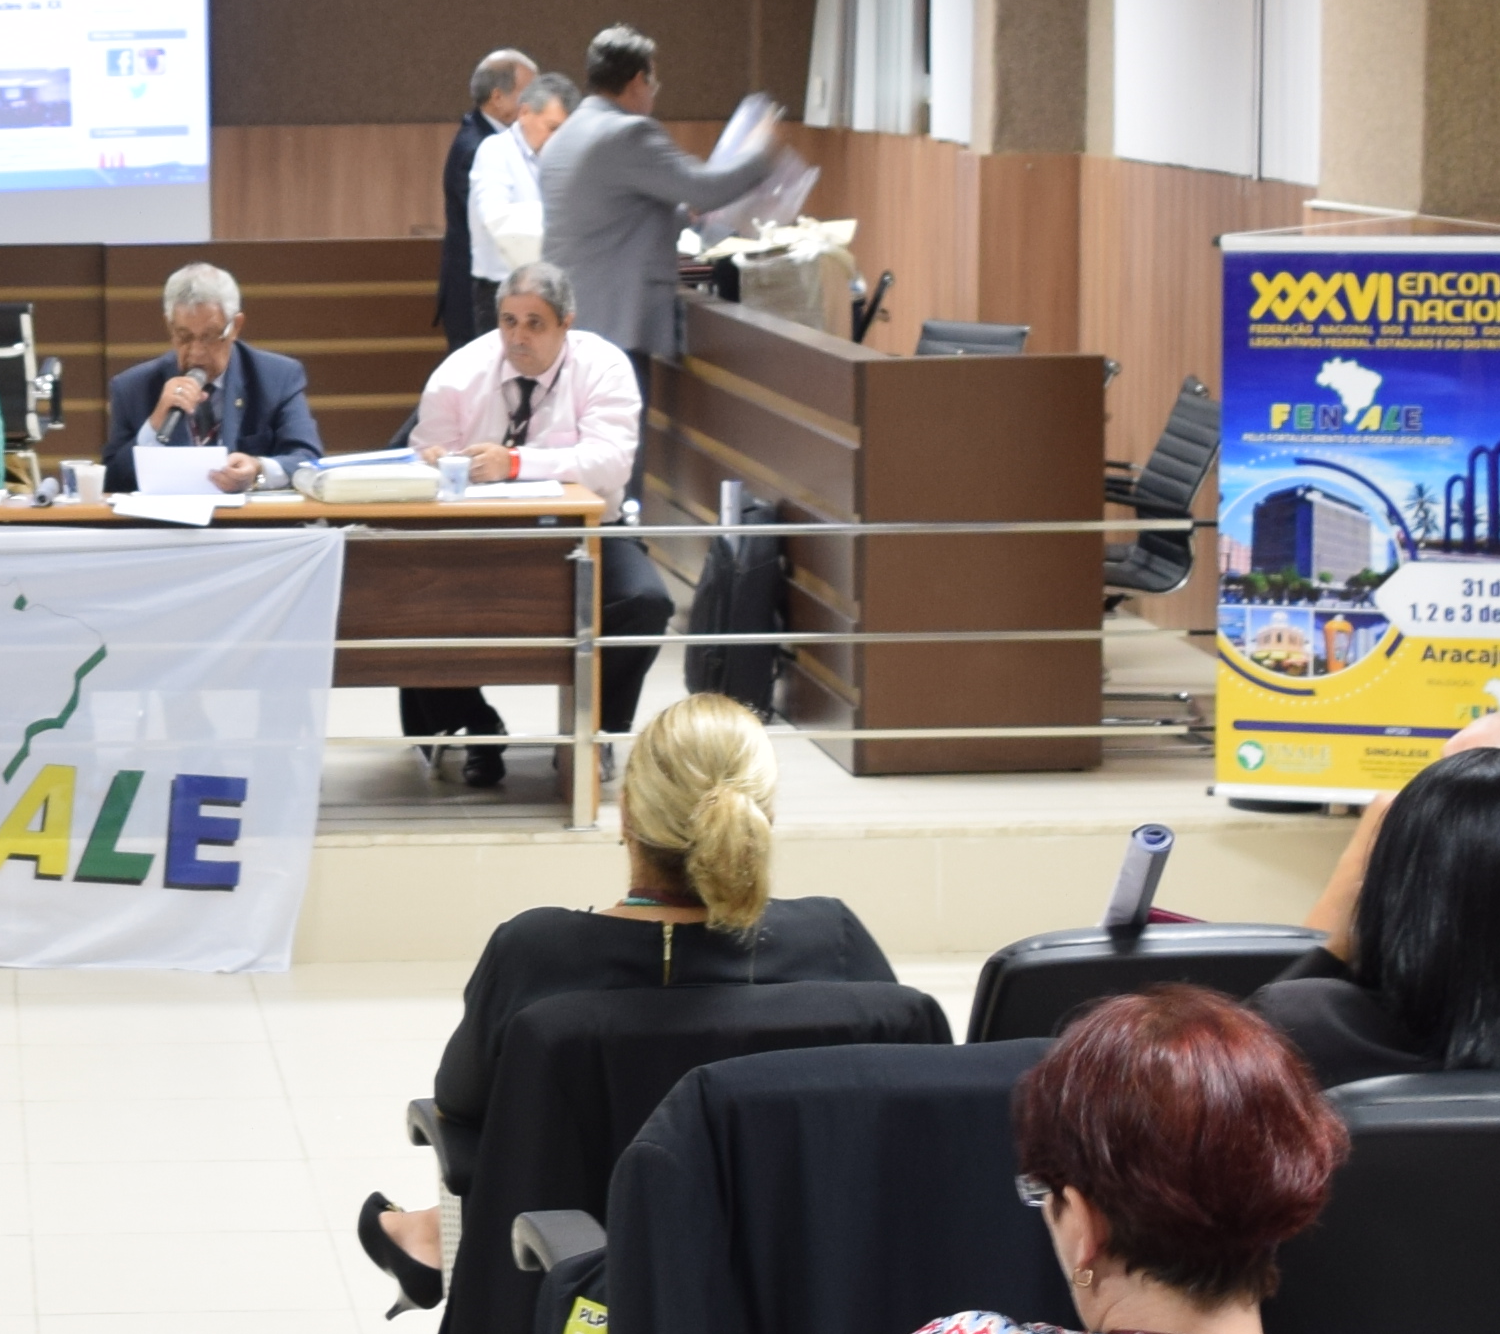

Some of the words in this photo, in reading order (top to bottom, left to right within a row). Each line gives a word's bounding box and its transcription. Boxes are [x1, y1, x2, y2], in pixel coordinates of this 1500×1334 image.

[1249, 271, 1393, 322] XXXVI
[1318, 324, 1374, 335] NACIONAL
[1270, 402, 1422, 433] FENALE
[1462, 579, 1485, 597] 31
[1426, 603, 1438, 622] 2
[1444, 608, 1455, 622] e
[1461, 604, 1473, 623] 3
